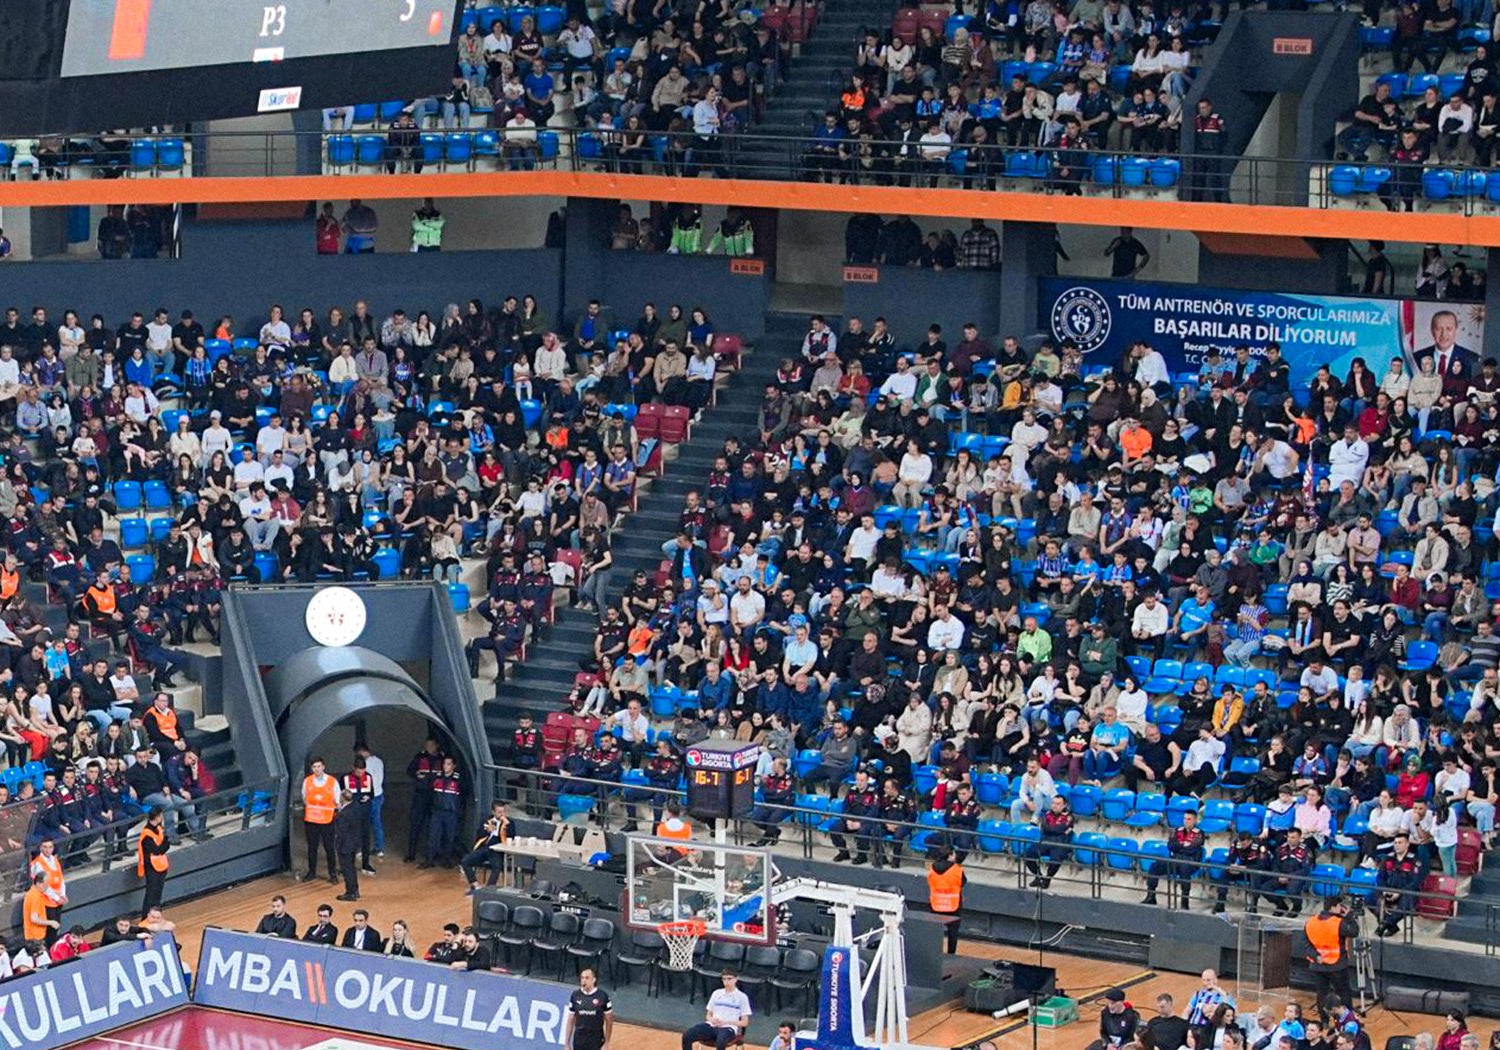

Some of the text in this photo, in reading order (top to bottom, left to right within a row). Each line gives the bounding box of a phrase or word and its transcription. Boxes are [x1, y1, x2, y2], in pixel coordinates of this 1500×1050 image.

[259, 5, 287, 36] P3
[1118, 294, 1392, 326] TÜM ANTRENÖR VE SPORCULARIMIZA
[1154, 318, 1357, 346] BAŞARILAR DİLİYORUM
[1184, 342, 1209, 352] Recep
[205, 947, 569, 1046] MBA OKULLARI
